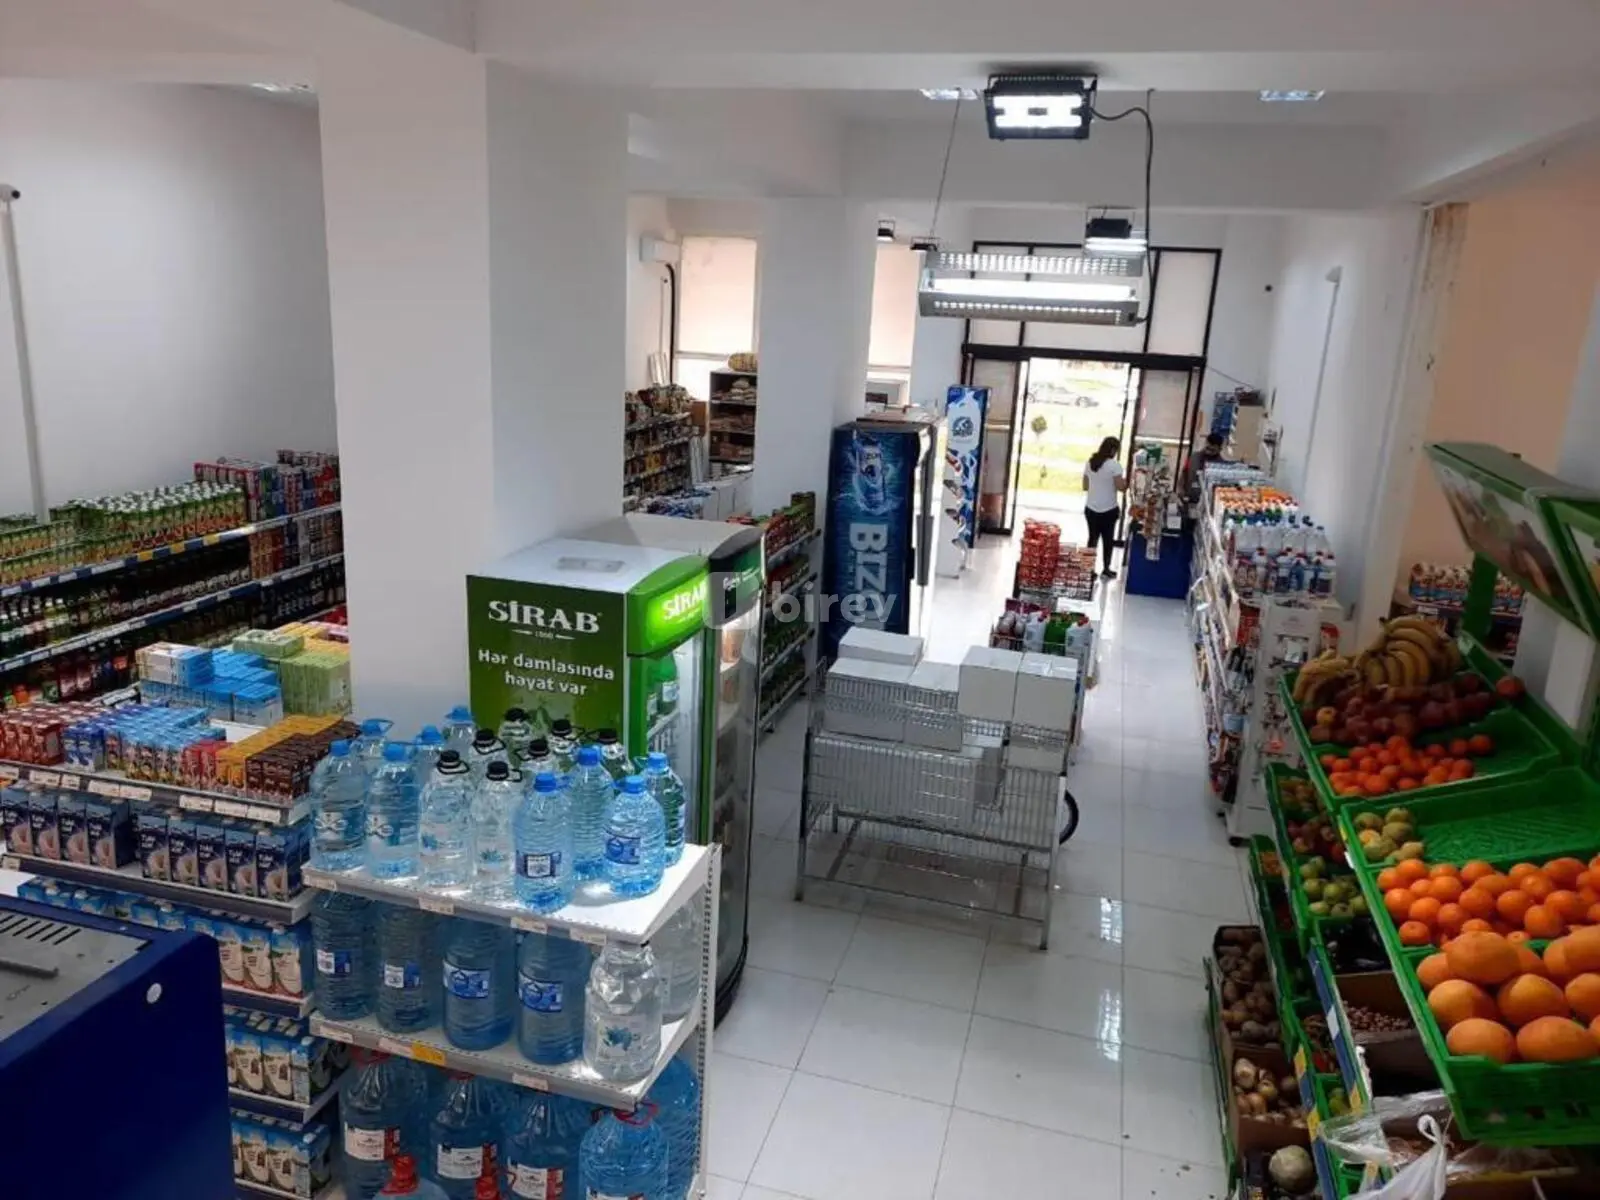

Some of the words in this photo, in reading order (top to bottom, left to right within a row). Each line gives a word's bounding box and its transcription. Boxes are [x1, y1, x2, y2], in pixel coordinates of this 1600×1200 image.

[478, 649, 508, 665] Hər
[513, 653, 614, 681] damlasında
[559, 681, 587, 696] var
